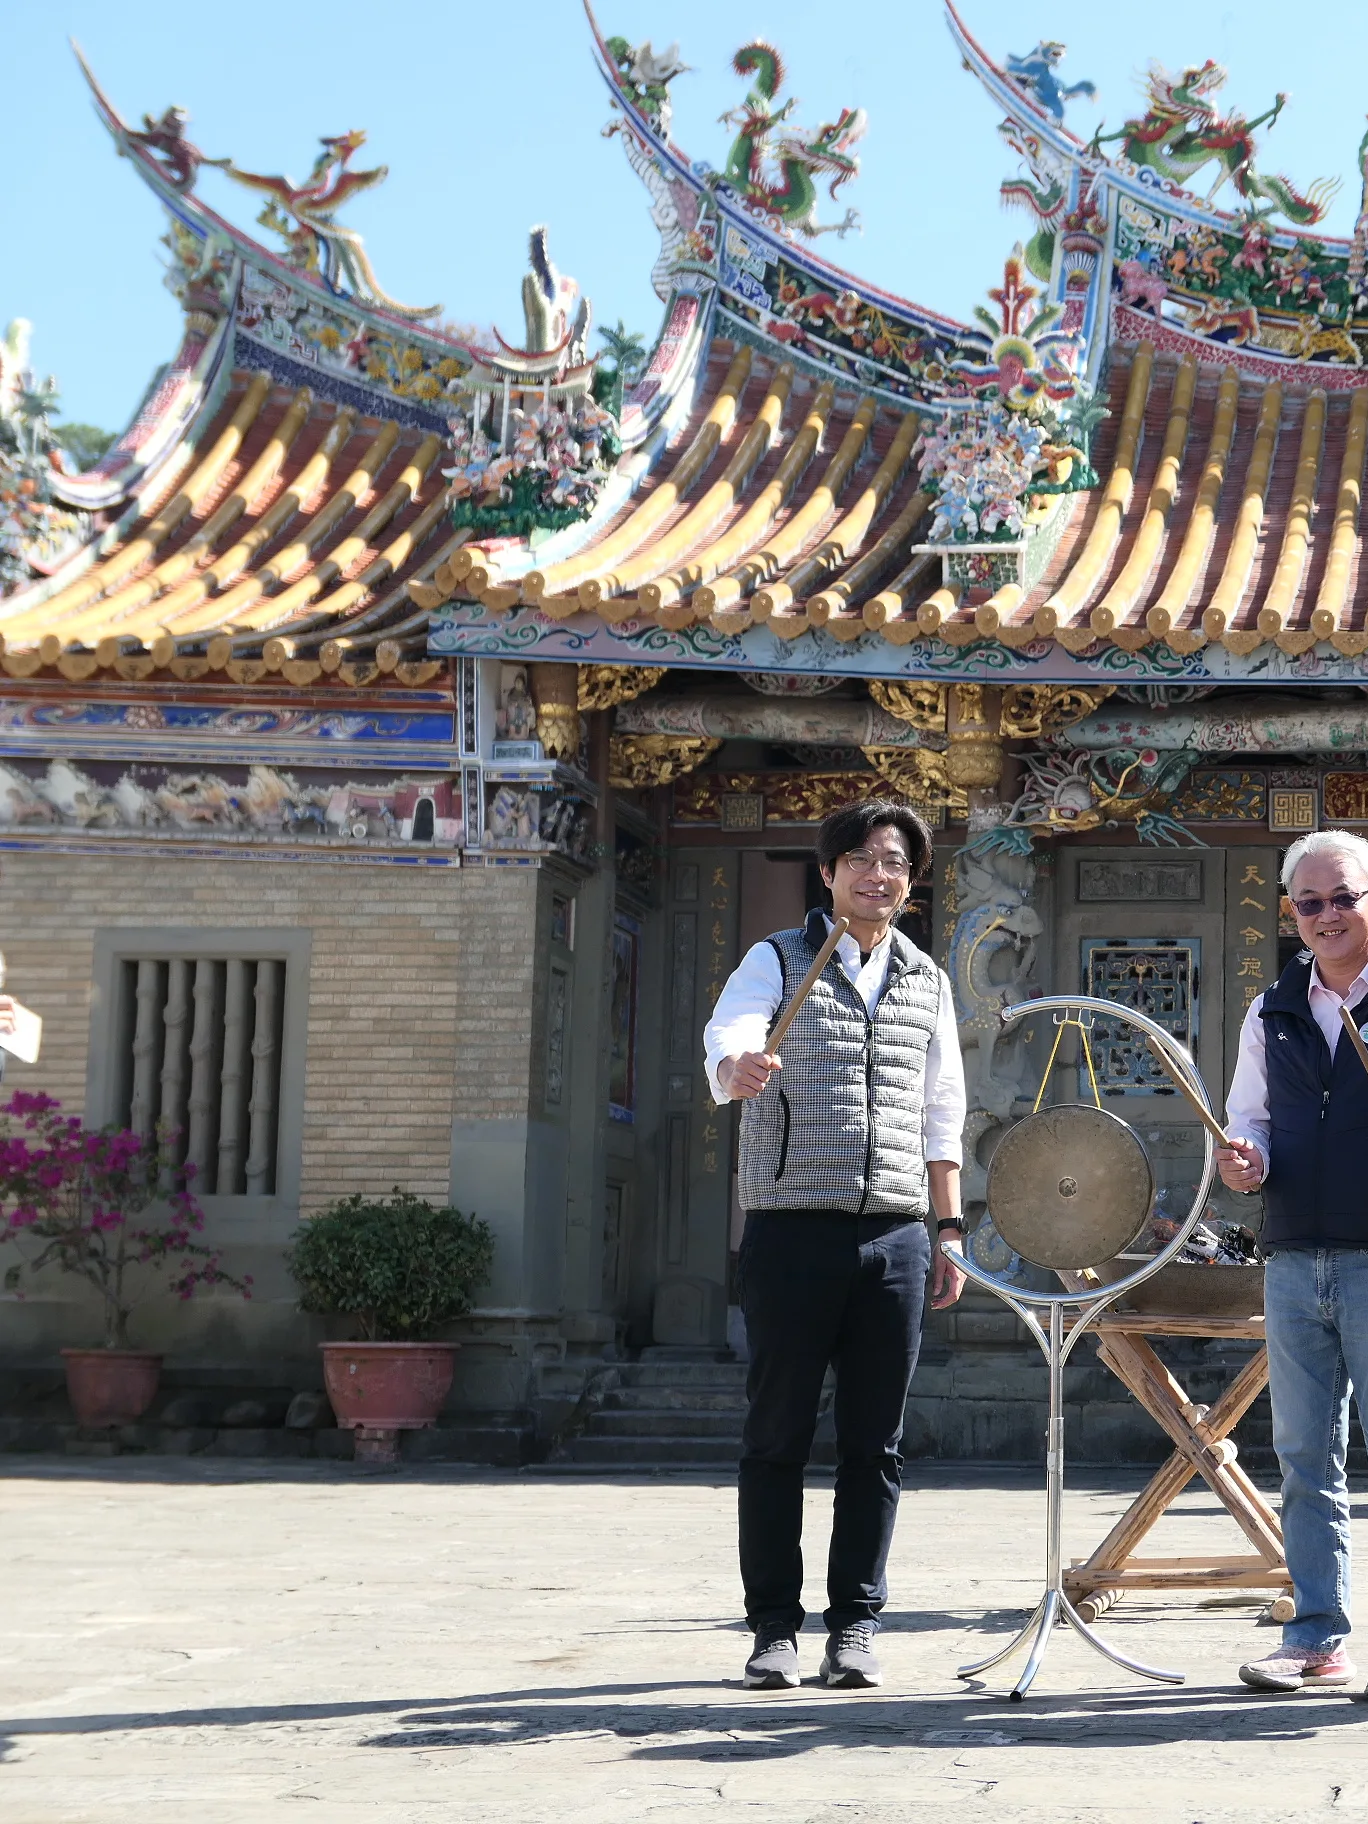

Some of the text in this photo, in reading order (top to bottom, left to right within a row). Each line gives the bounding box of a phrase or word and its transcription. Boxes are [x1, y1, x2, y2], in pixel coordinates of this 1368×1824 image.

[1237, 865, 1266, 1028] 天人合德恩
